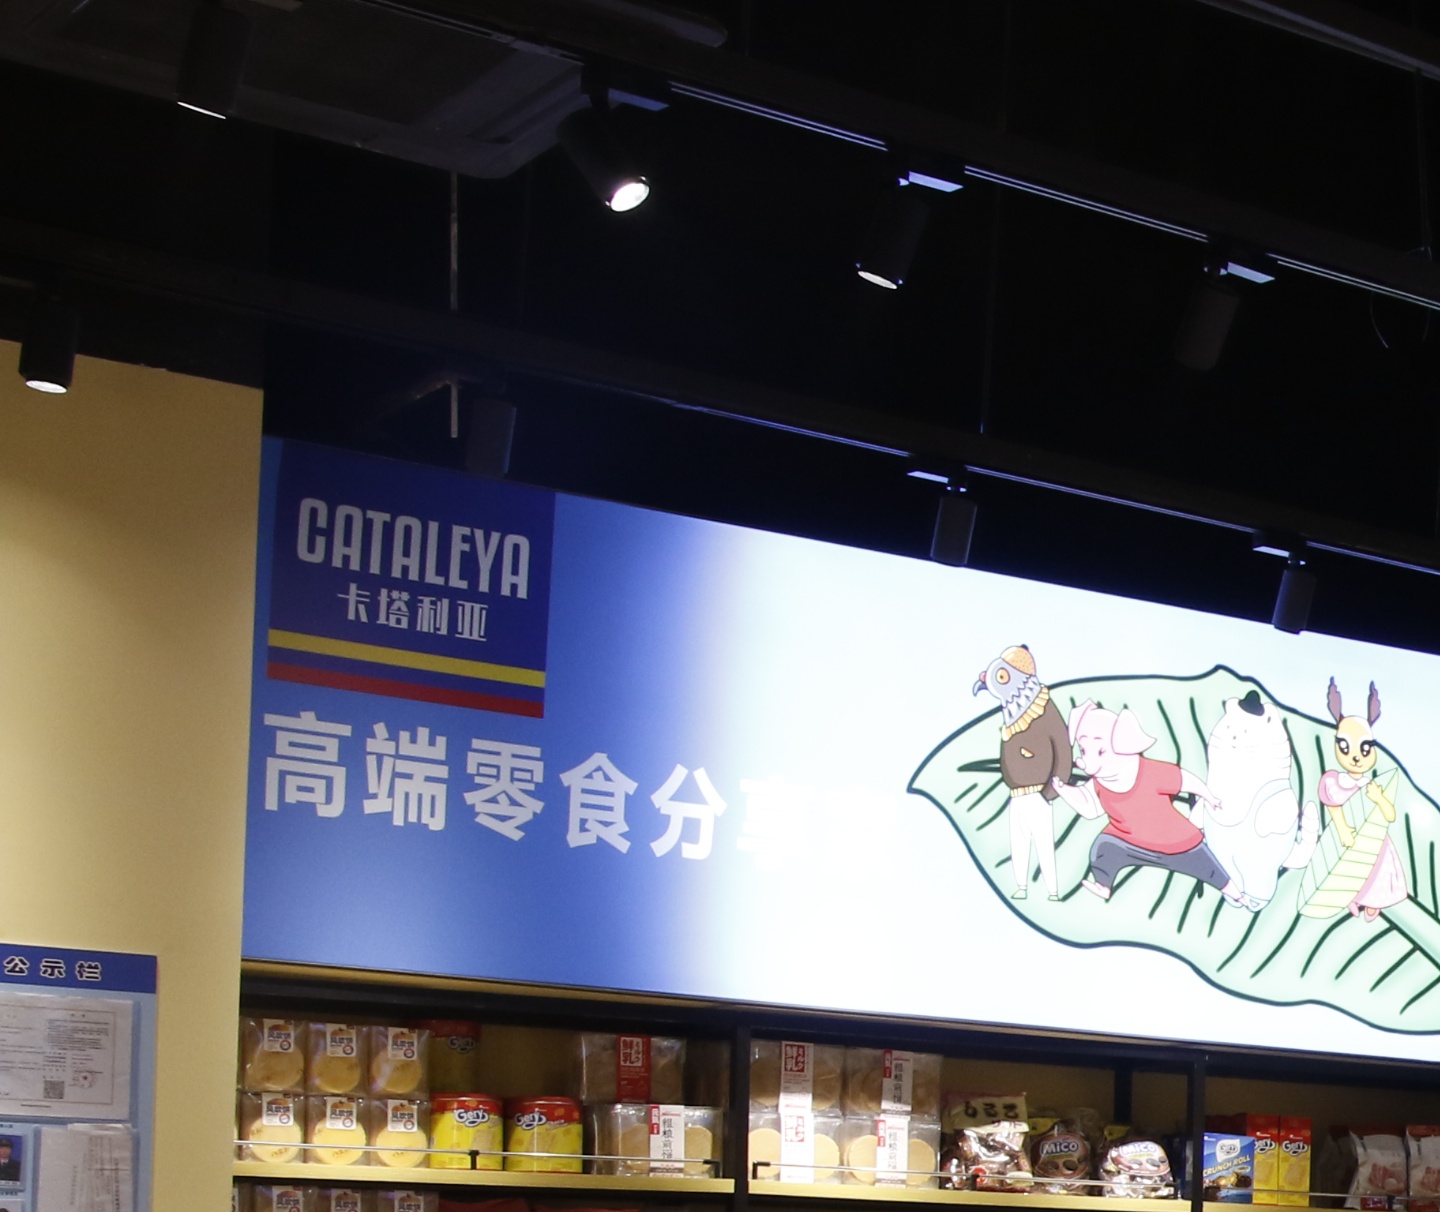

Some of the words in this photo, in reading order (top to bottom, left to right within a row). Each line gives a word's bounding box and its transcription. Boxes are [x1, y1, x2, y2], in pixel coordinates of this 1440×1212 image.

[296, 496, 530, 599] CATALEYA
[337, 583, 488, 642] 卡塔利亚
[1202, 1159, 1233, 1177] CRUNCH
